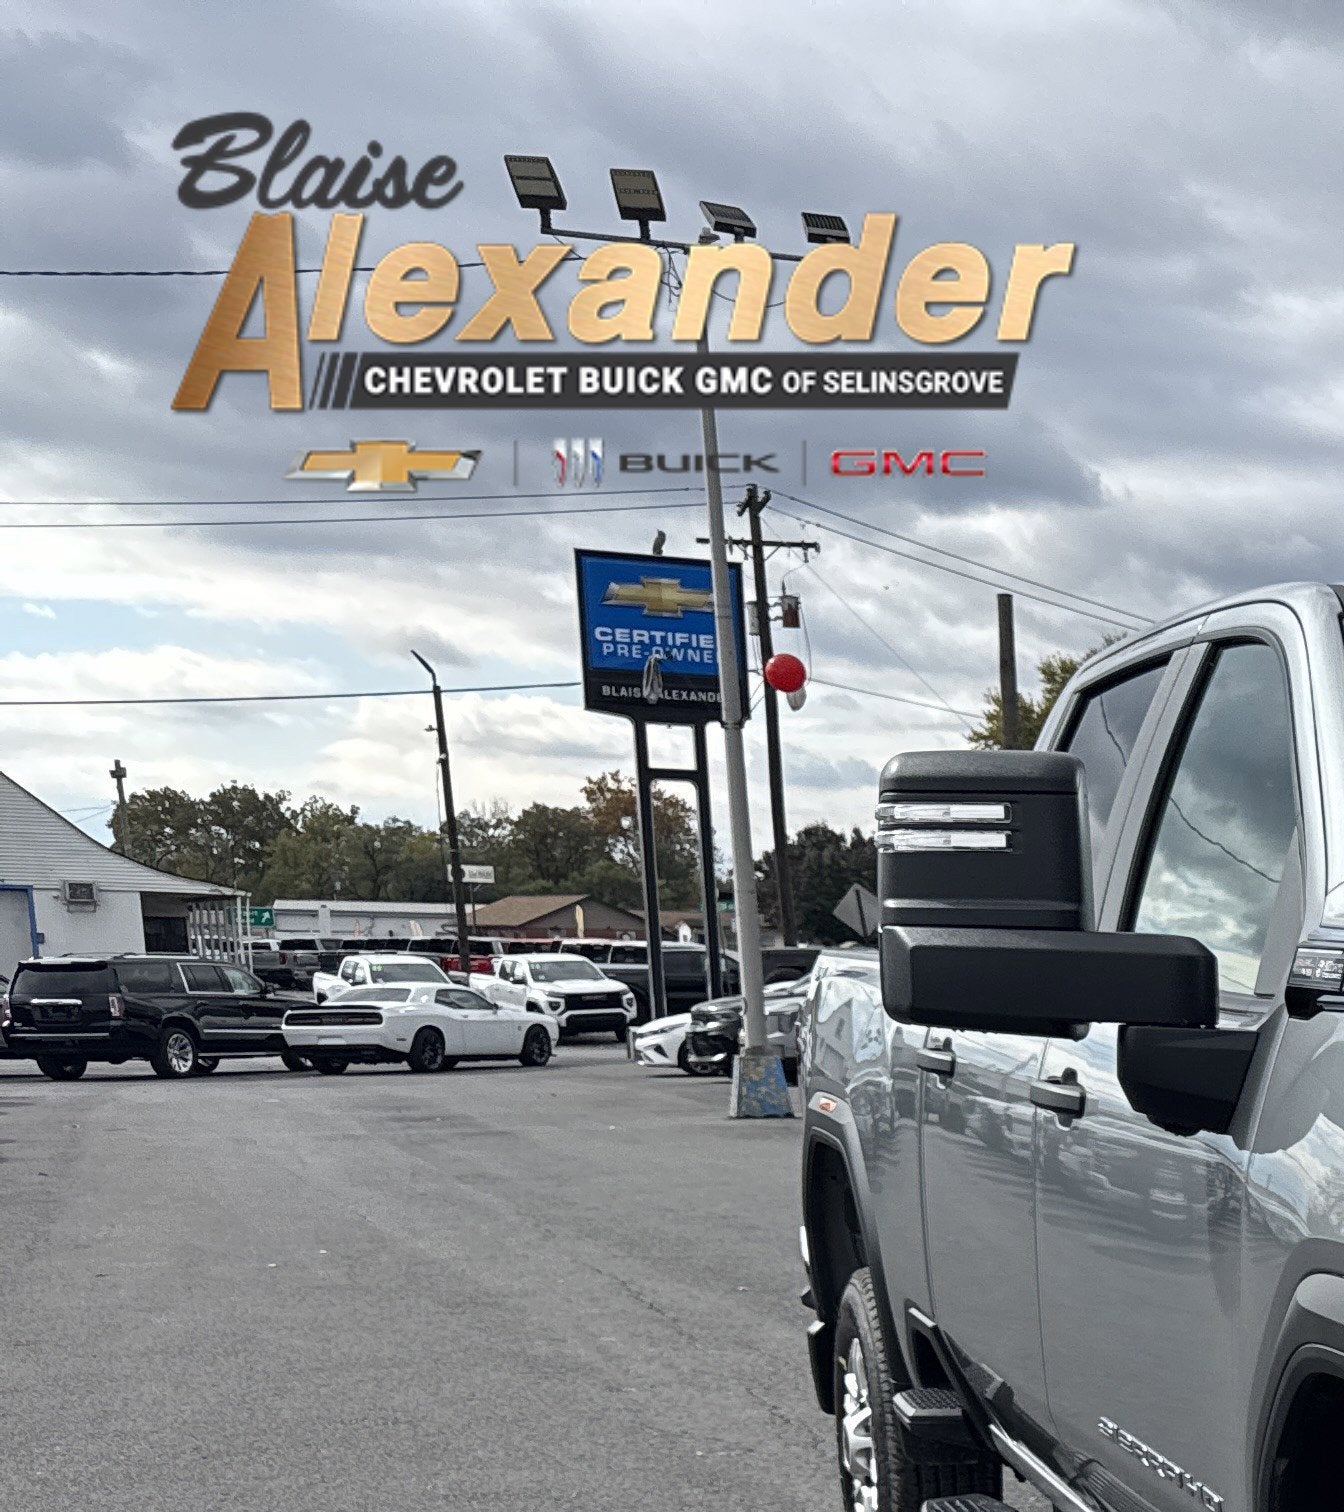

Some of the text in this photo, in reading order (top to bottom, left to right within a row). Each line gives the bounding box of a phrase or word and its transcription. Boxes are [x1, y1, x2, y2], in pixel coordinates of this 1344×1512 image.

[594, 626, 714, 649] CERTIFIE
[602, 642, 718, 664] PRE-OWNE
[602, 685, 641, 698] BLAIS
